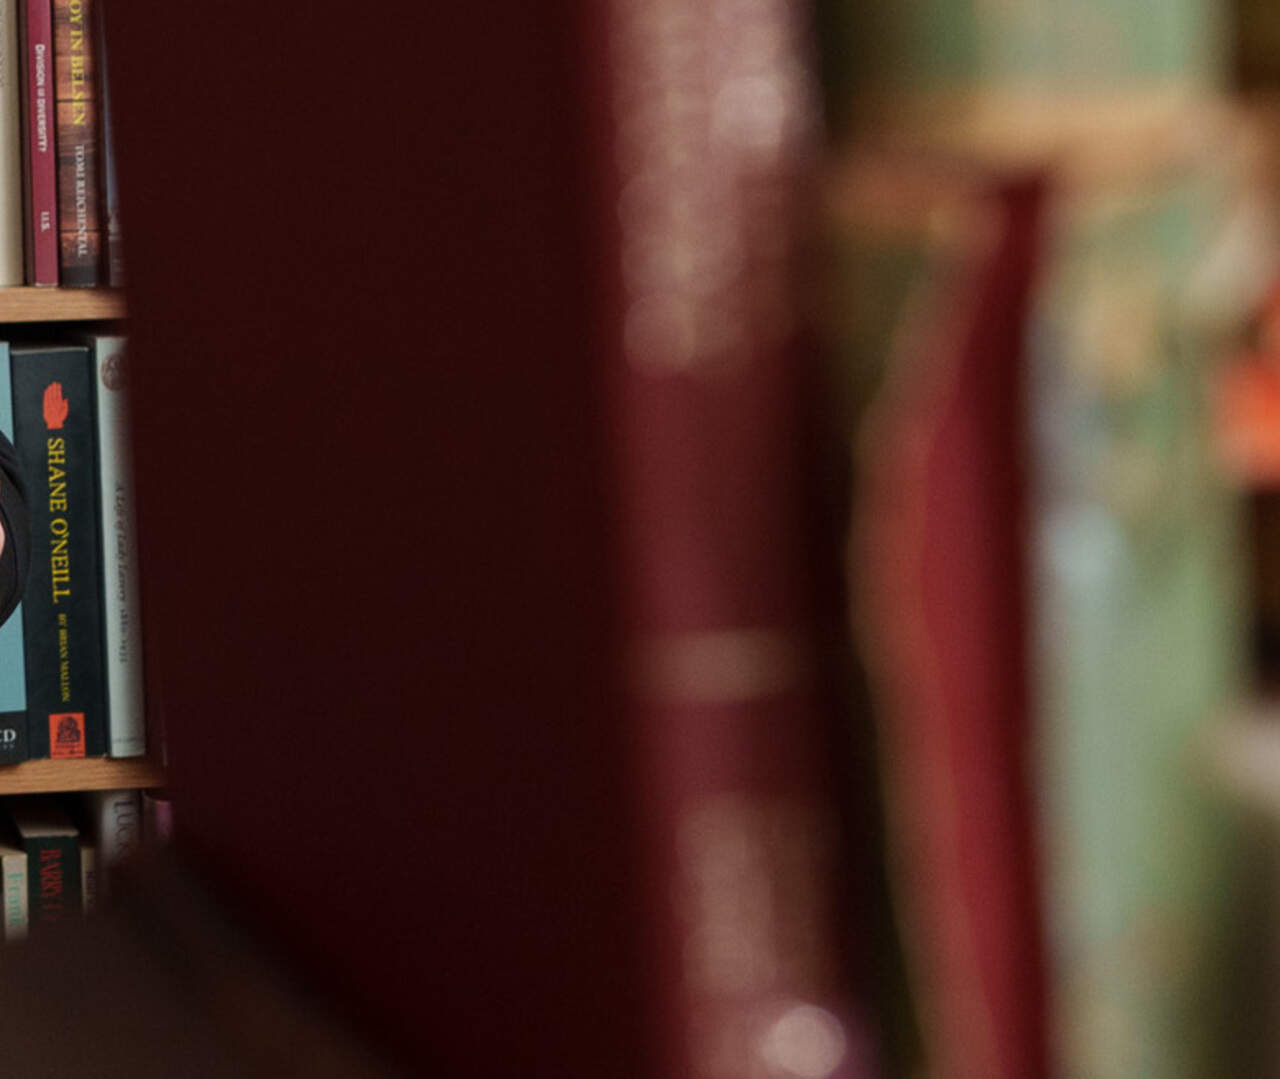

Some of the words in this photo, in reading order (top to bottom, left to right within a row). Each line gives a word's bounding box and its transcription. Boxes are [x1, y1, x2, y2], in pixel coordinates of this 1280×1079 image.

[70, 28, 85, 51] IN
[34, 43, 47, 86] DIVISION
[71, 55, 89, 126] BELSEN
[74, 144, 87, 177] TOMI
[75, 179, 90, 257] REICHENTAL
[47, 436, 67, 513] SHANE
[48, 517, 72, 604] O'NEILL
[58, 628, 70, 659] BRIAN
[59, 661, 71, 702] MALLON
